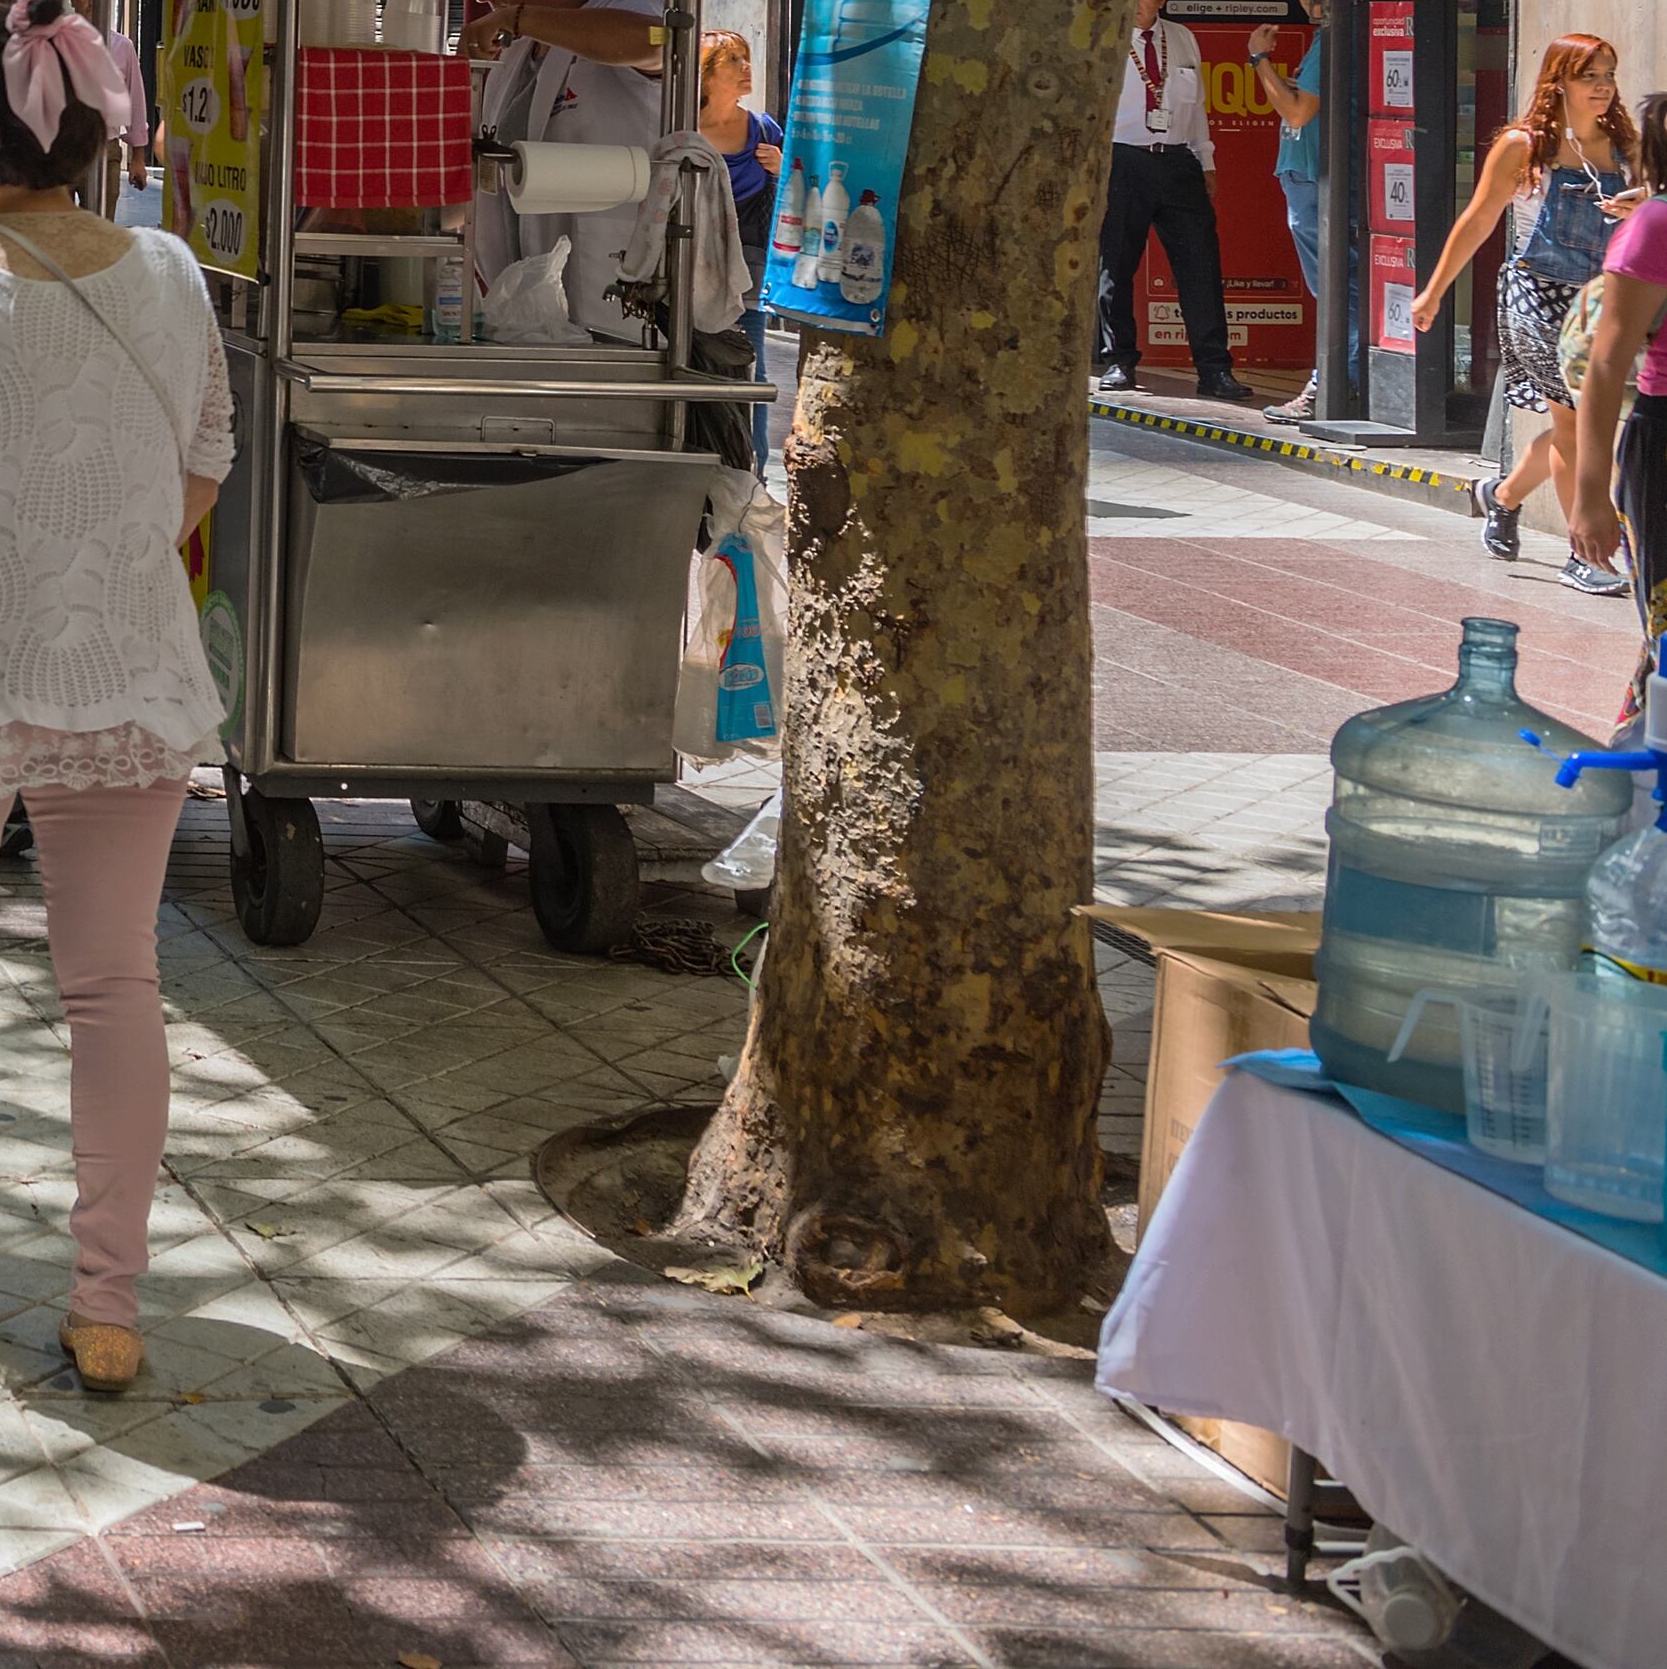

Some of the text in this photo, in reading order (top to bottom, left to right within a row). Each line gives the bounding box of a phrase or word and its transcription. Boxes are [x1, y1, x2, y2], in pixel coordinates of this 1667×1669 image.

[1187, 3, 1213, 14] elige
[1225, 4, 1278, 16] ripley.com
[1236, 308, 1298, 322] productos
[1154, 329, 1172, 340] en
